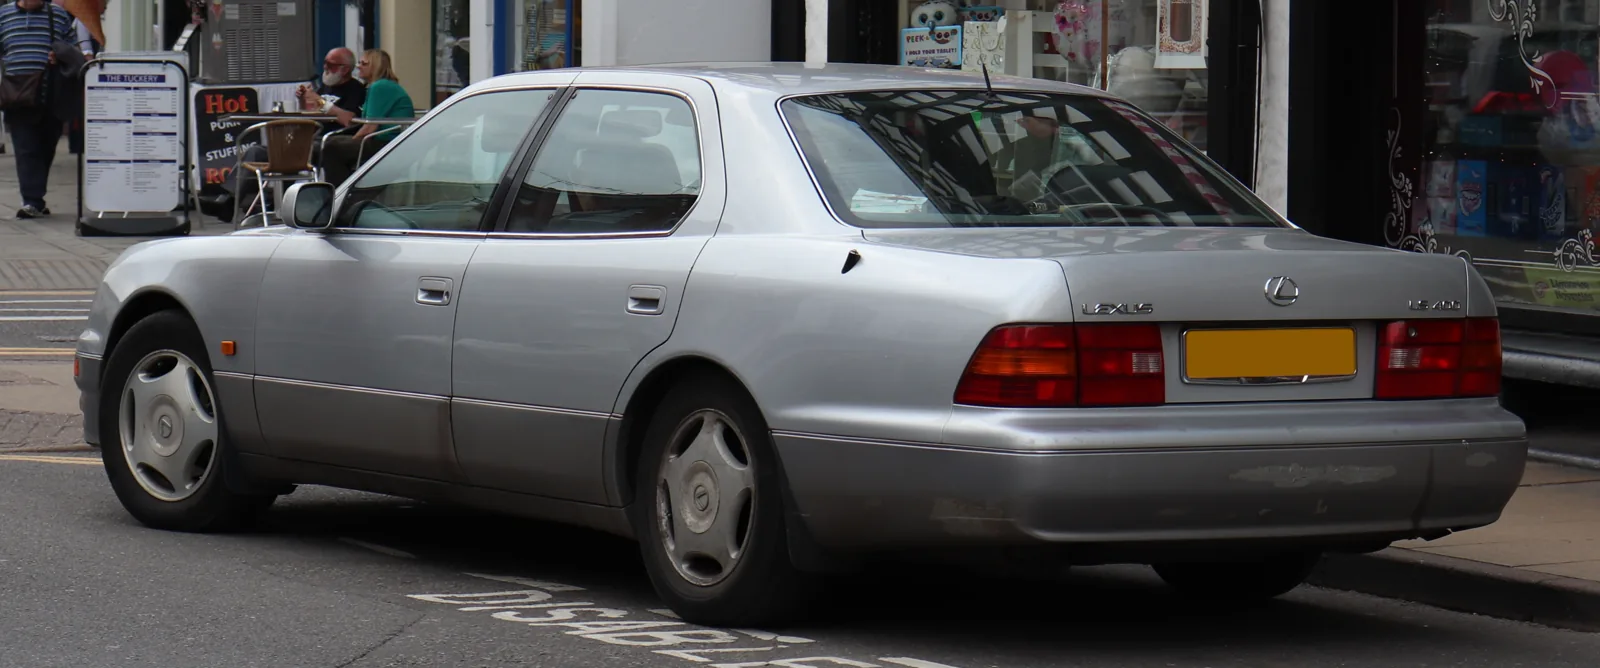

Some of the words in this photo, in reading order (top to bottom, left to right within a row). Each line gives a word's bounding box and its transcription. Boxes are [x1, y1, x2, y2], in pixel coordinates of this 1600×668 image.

[205, 94, 249, 114] Hot
[224, 133, 234, 143] &
[1082, 303, 1154, 315] LEXUS
[1408, 300, 1429, 311] LS
[1432, 300, 1461, 311] 400
